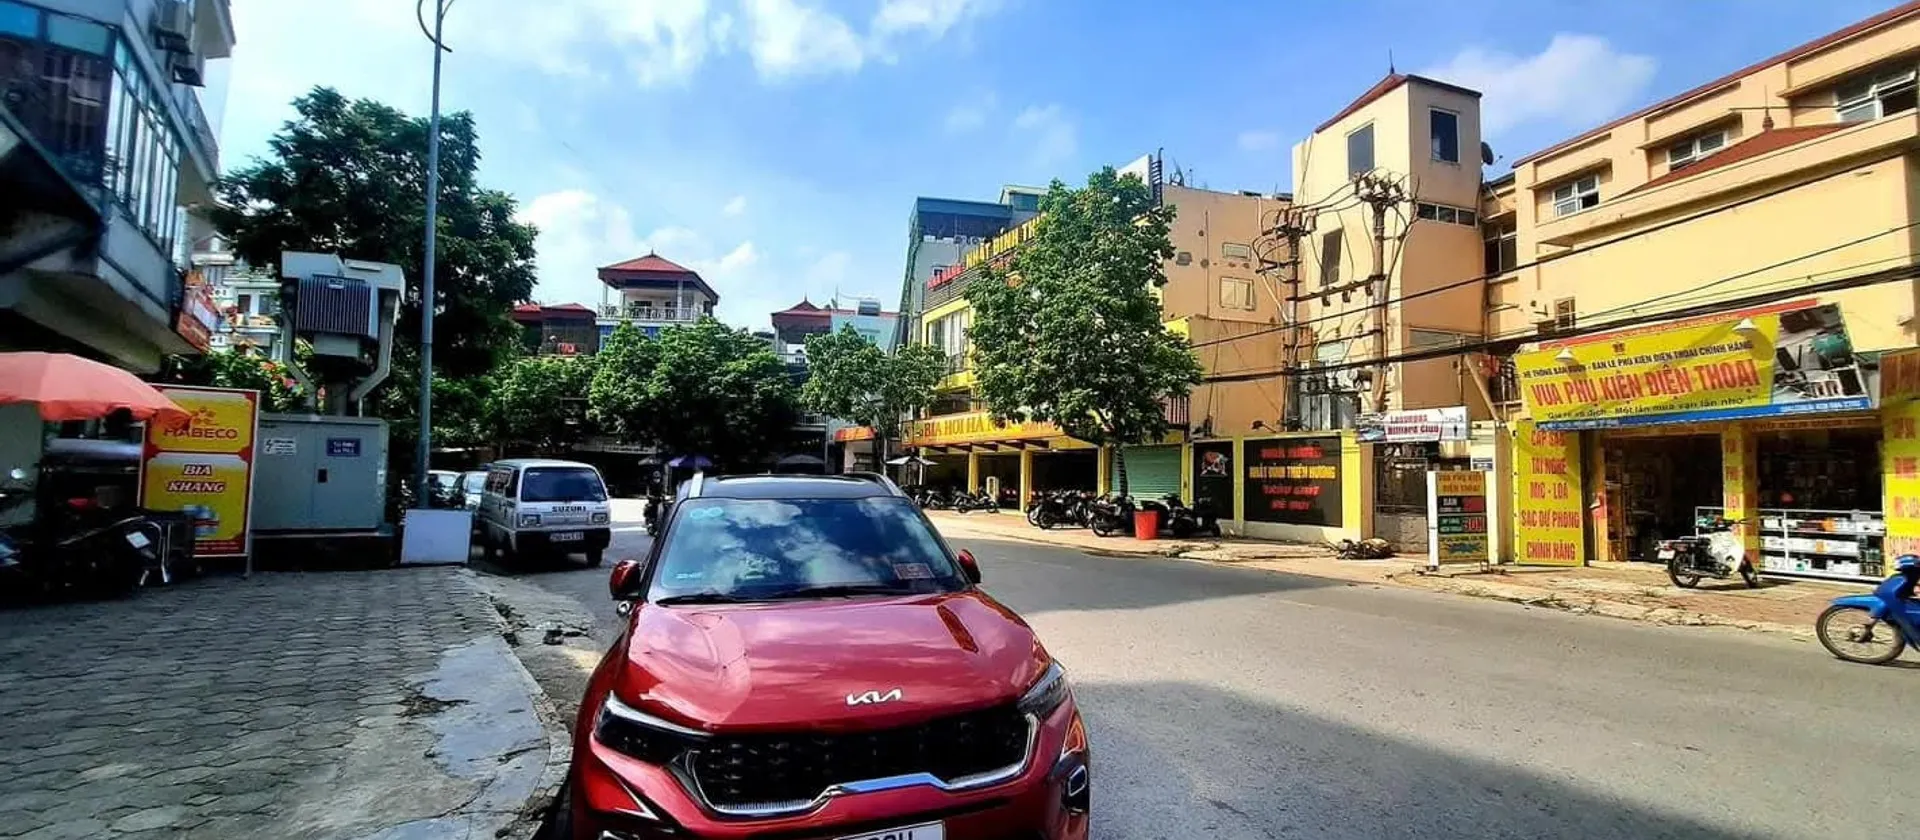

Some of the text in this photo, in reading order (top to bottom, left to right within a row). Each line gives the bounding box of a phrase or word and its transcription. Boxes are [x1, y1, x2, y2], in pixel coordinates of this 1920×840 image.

[1531, 359, 1760, 407] VUA PHỤ KIỆN ĐIỆN THOẠI
[164, 427, 238, 439] HABECO
[184, 464, 212, 476] BIA
[167, 481, 226, 493] KHANG
[1530, 482, 1545, 499] MIC
[1553, 482, 1568, 499] LOA
[551, 505, 587, 513] SUZUKI
[1521, 509, 1537, 530] SẠC
[1552, 507, 1579, 529] PHÒNG
[1527, 538, 1552, 559] CHÍNH
